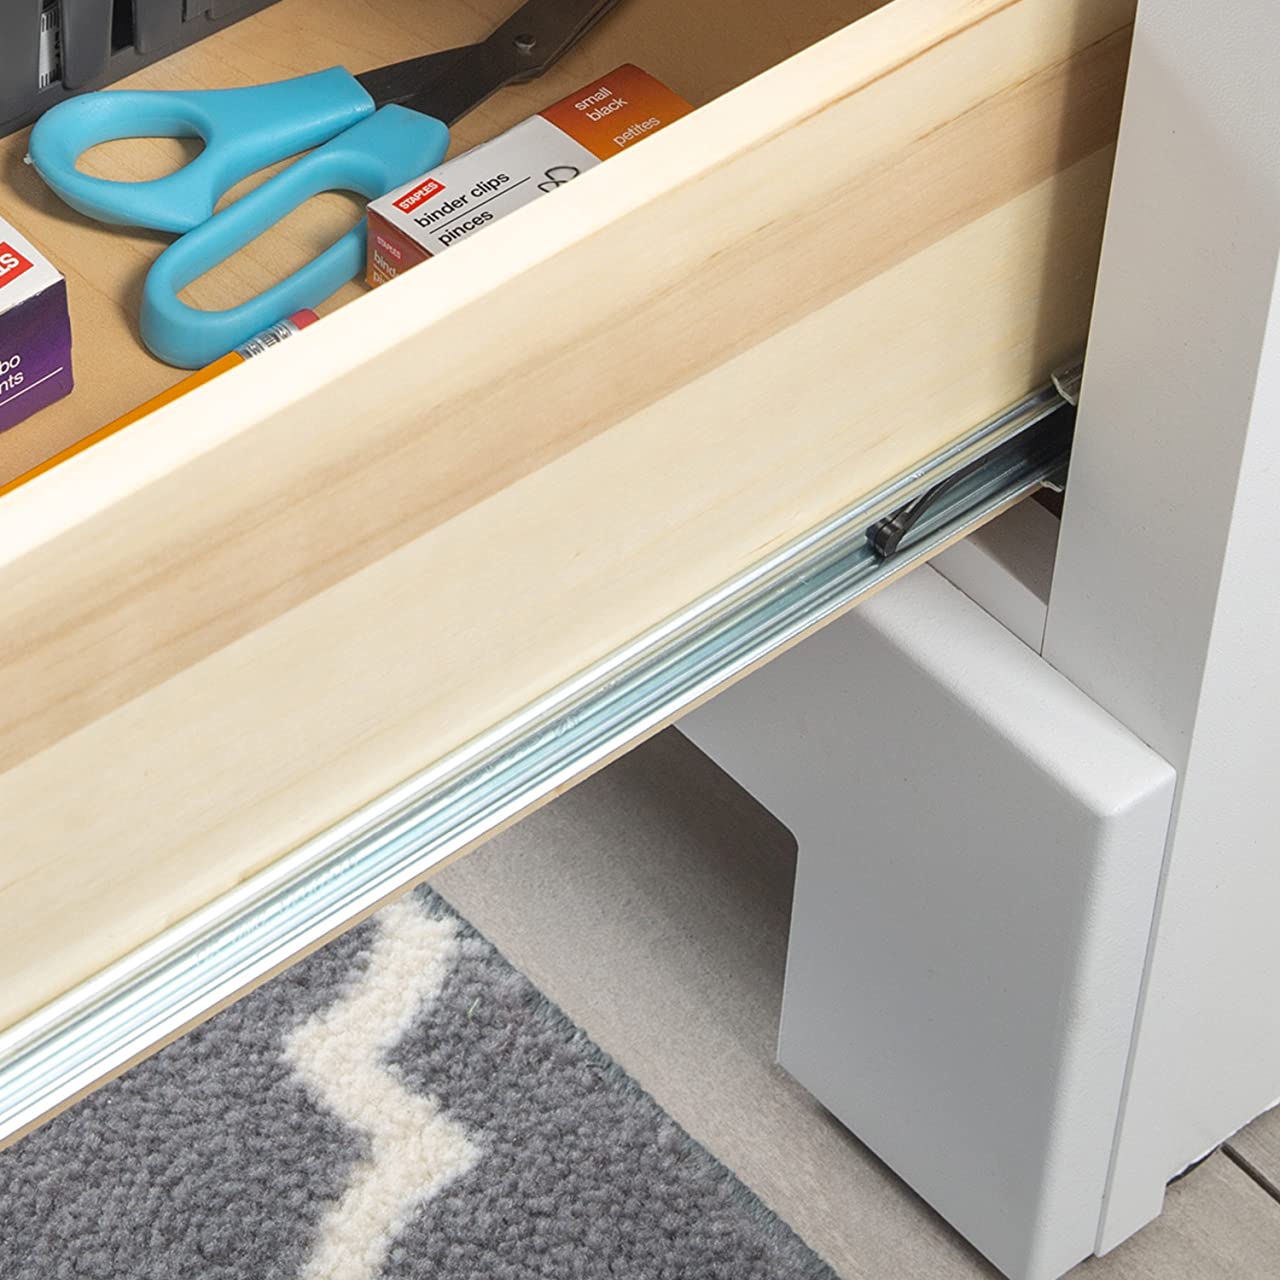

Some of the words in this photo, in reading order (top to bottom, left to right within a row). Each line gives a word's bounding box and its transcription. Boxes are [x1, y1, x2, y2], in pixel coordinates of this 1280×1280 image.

[575, 86, 613, 111] small
[586, 97, 629, 122] black
[613, 117, 661, 147] petites
[399, 181, 439, 210] STAPLES
[414, 194, 469, 228] binder
[470, 173, 510, 198] clips
[438, 210, 494, 247] pinces
